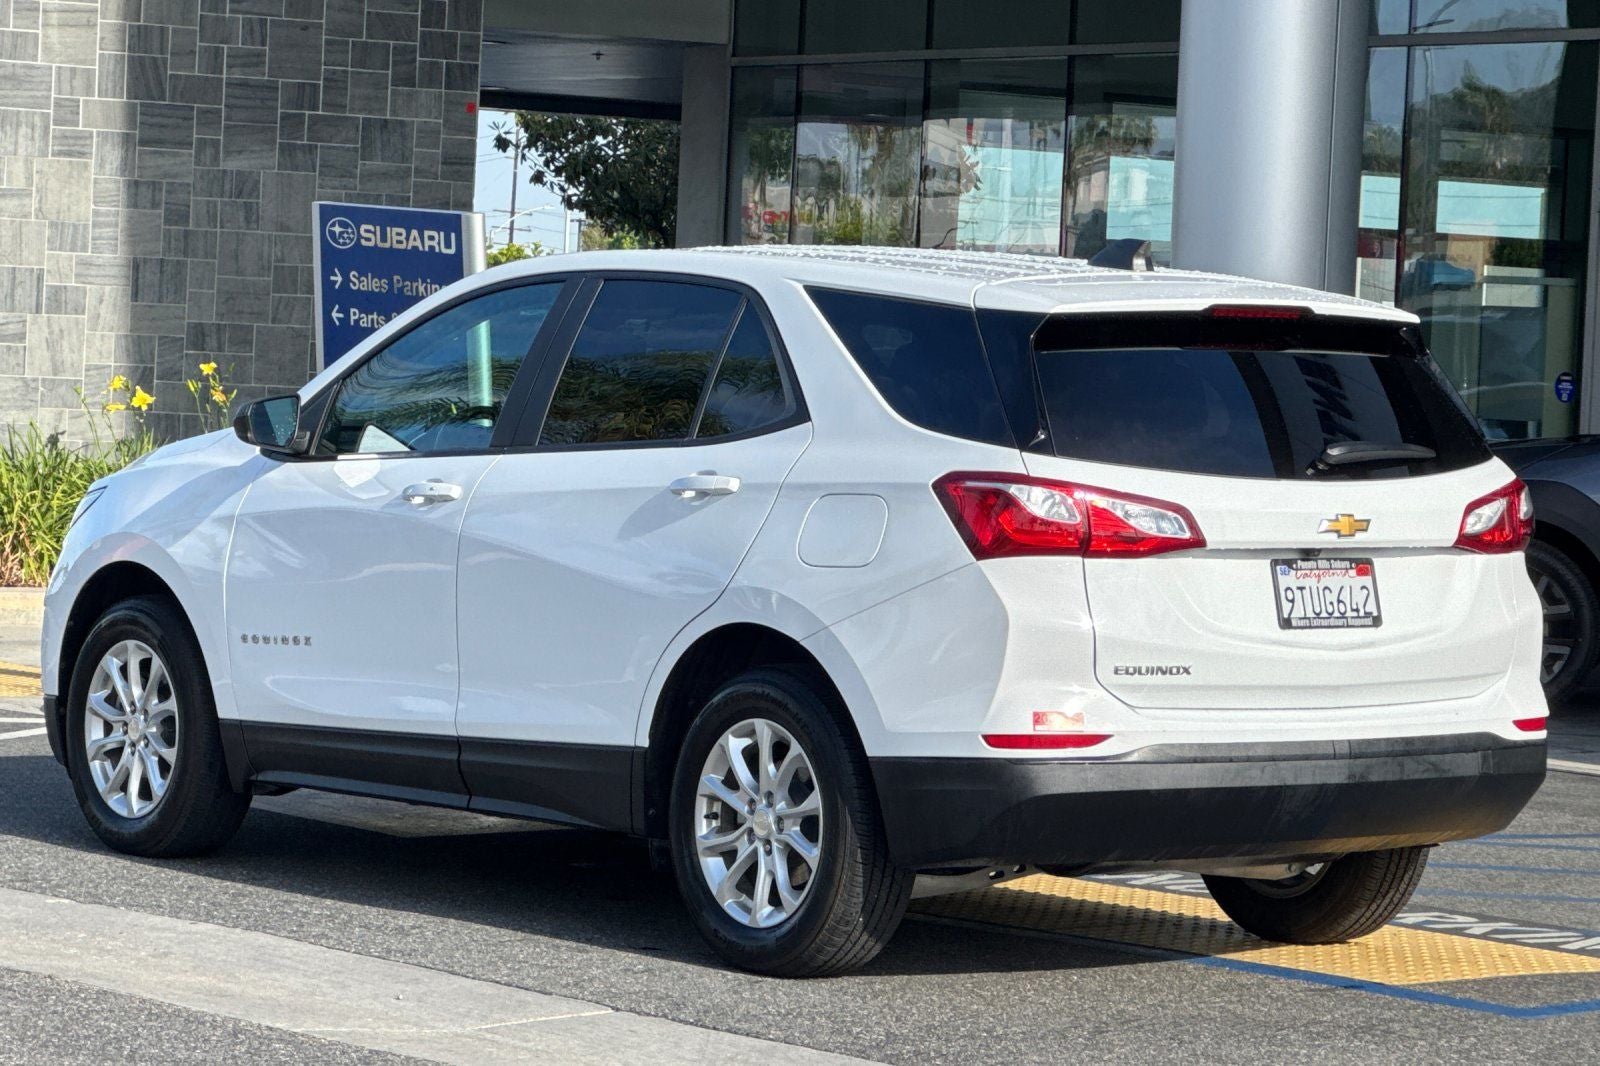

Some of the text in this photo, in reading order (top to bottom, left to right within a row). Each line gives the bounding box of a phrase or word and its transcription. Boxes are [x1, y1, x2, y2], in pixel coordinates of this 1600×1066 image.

[360, 224, 456, 254] SUBARU
[350, 271, 388, 293] Sales
[350, 309, 386, 328] Parts
[1284, 586, 1373, 617] 9TUG642
[1113, 664, 1192, 676] EQUINOX
